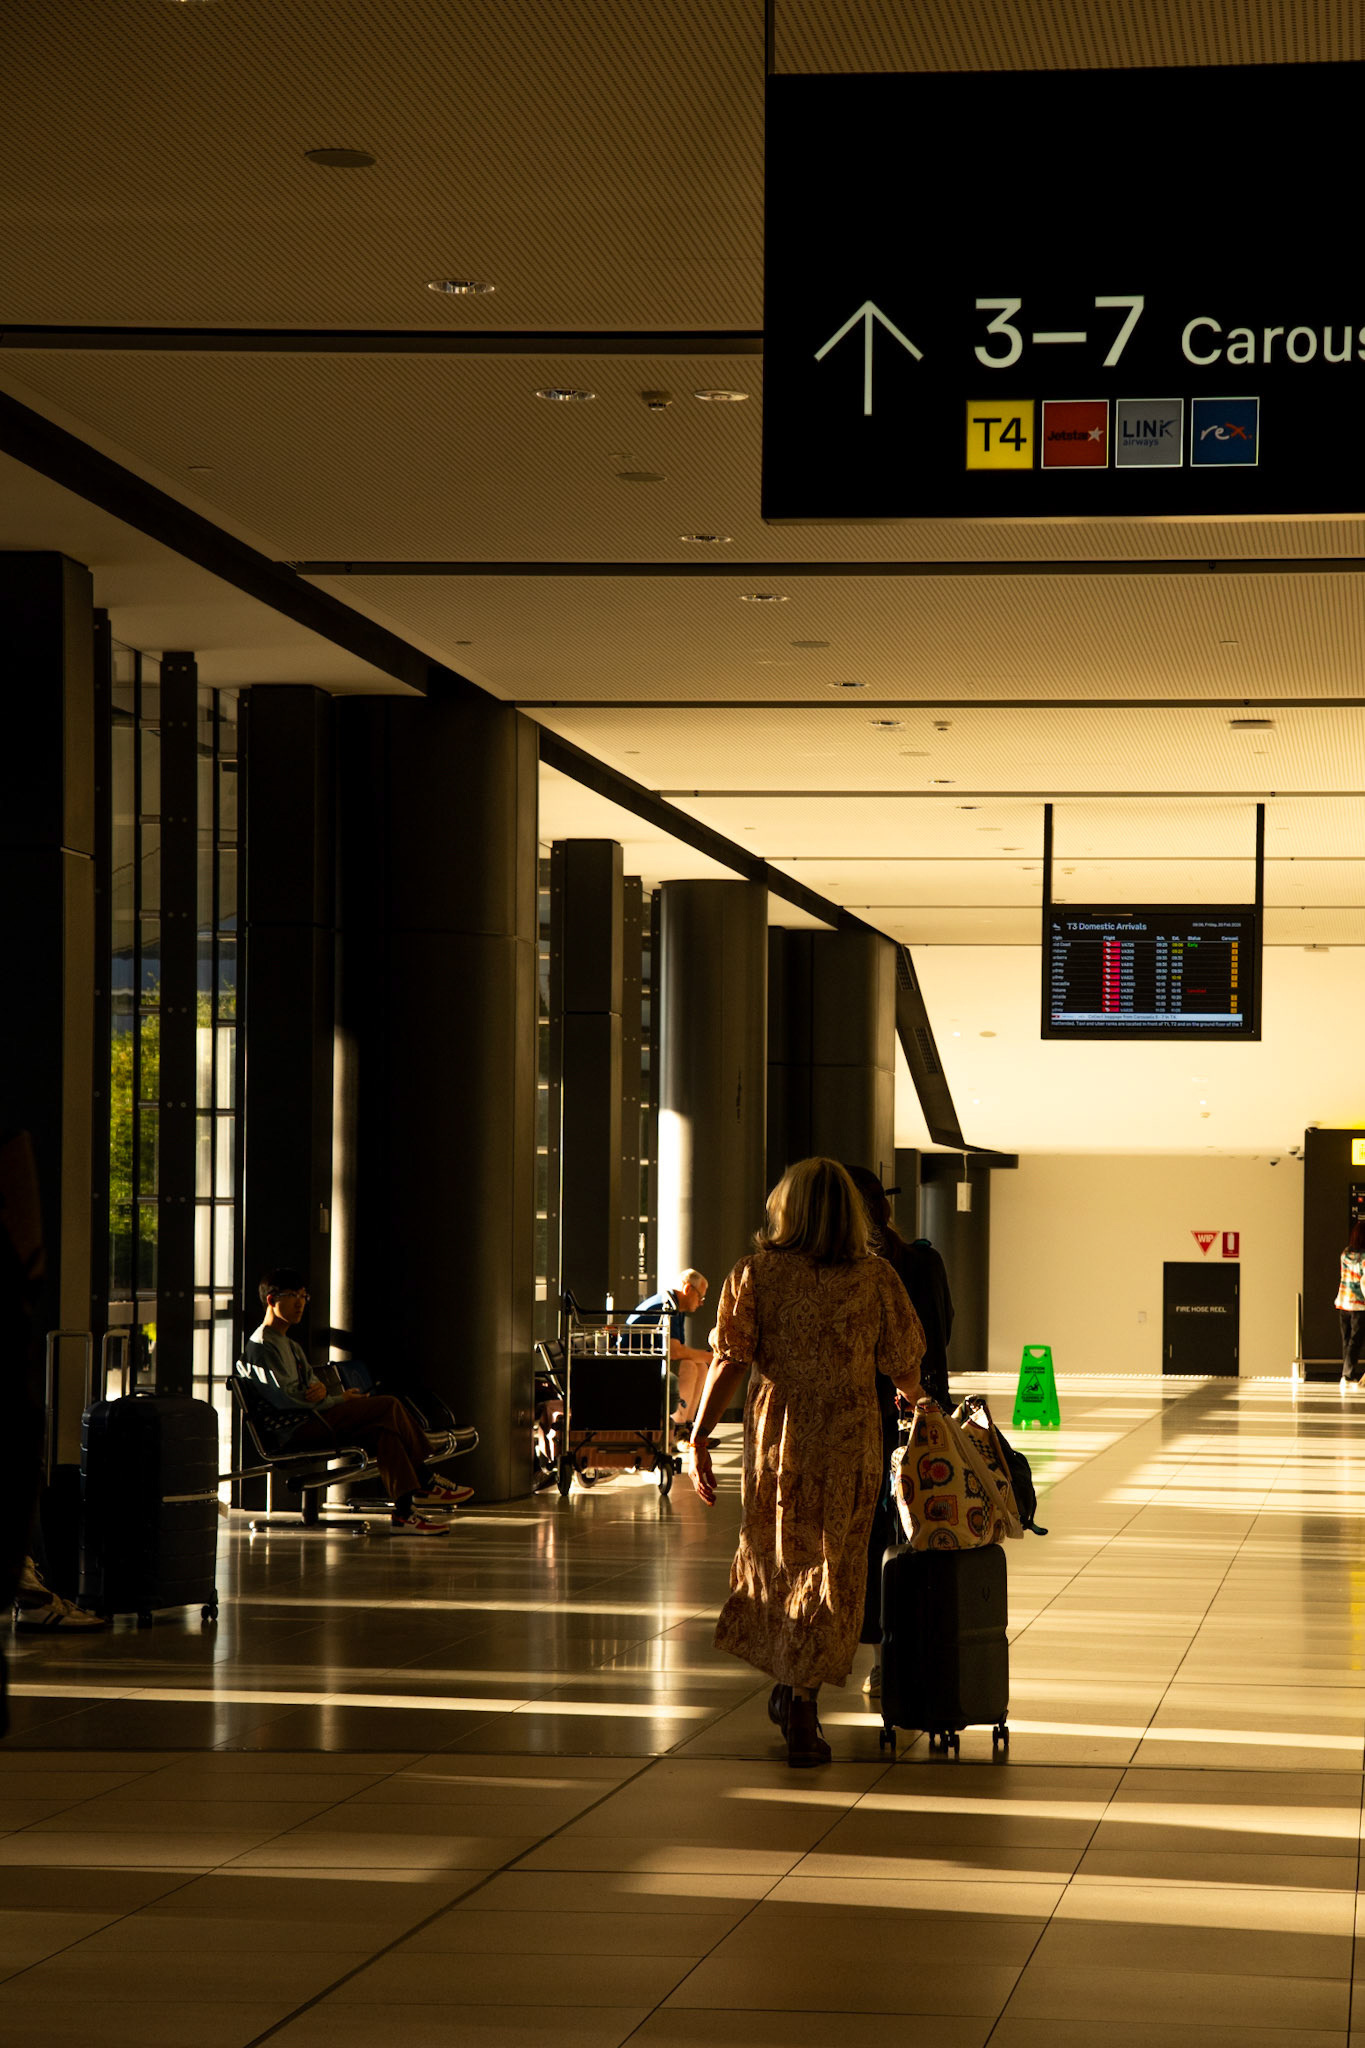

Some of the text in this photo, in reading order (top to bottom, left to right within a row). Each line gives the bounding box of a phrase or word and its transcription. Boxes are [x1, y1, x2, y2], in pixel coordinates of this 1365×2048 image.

[1182, 316, 1365, 366] Carou
[973, 417, 1027, 452] T4
[1123, 419, 1178, 438] LINK
[1123, 438, 1159, 447] airways
[1066, 922, 1147, 930] T3 Domestic Arrivals
[1198, 1234, 1214, 1243] WIP
